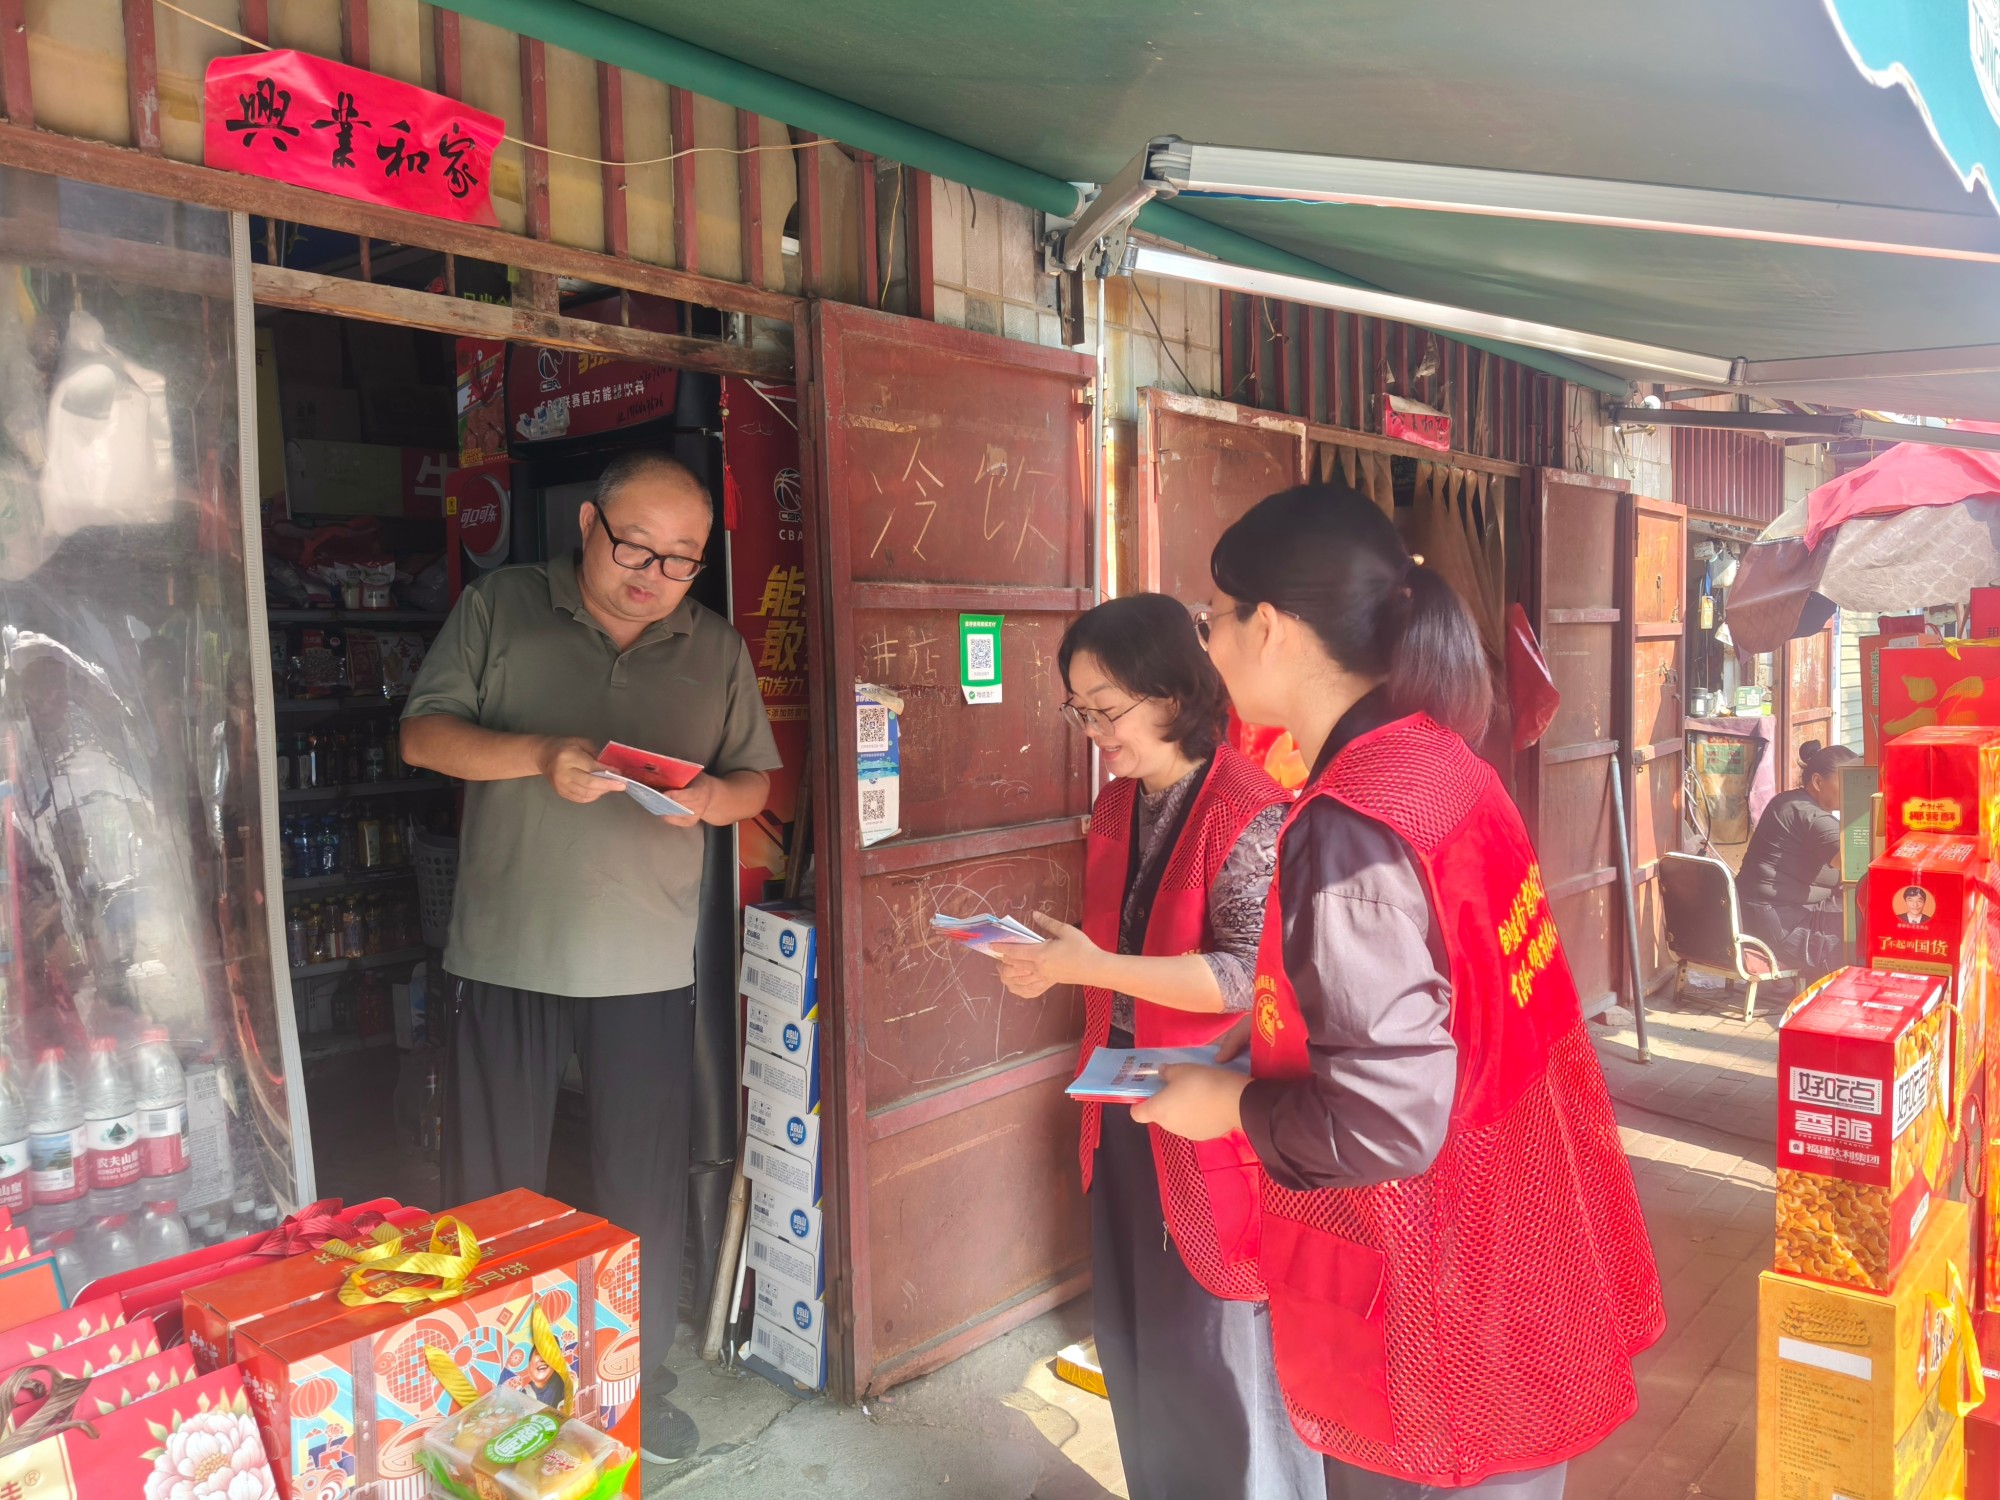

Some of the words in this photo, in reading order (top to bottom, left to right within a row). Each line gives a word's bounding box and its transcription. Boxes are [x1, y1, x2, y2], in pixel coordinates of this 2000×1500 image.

[541, 380, 645, 411] CB联赛官方能量饮料
[1878, 936, 1949, 957] 了不起的国货
[1797, 1071, 1875, 1104] 好吃点
[1897, 1061, 1928, 1123] 好吃点
[1795, 1110, 1873, 1143] 香脆
[96, 1150, 139, 1169] 农夫山泉
[1805, 1142, 1880, 1165] 福建达利集团
